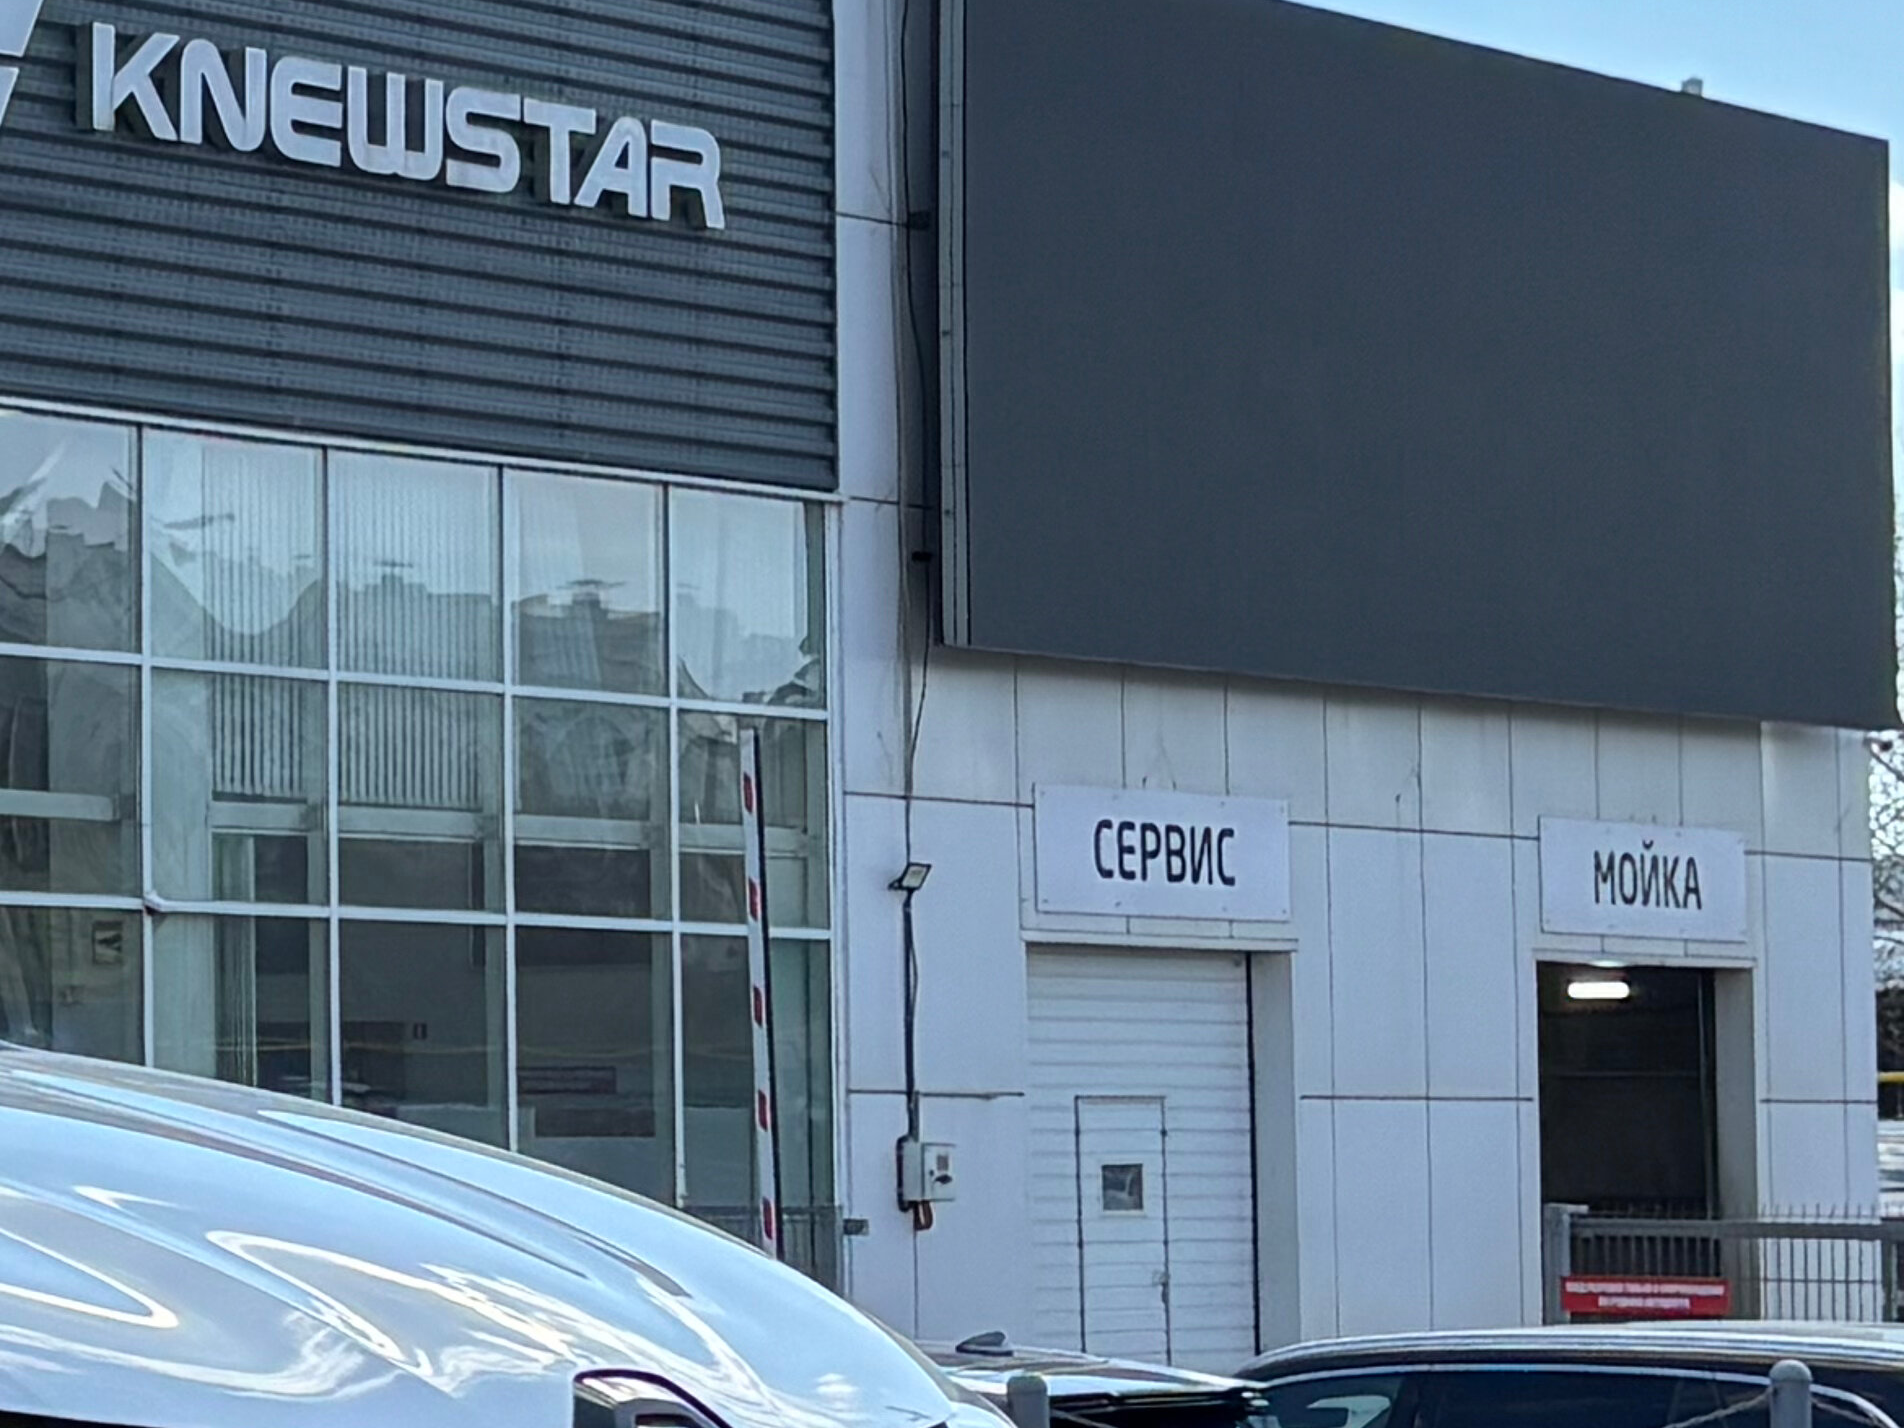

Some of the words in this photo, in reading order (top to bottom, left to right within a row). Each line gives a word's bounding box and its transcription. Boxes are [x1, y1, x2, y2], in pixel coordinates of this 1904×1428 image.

[80, 18, 727, 232] KNEWSTAR
[1092, 818, 1236, 888] СЕРВИС
[1592, 839, 1704, 911] МОЙКА
